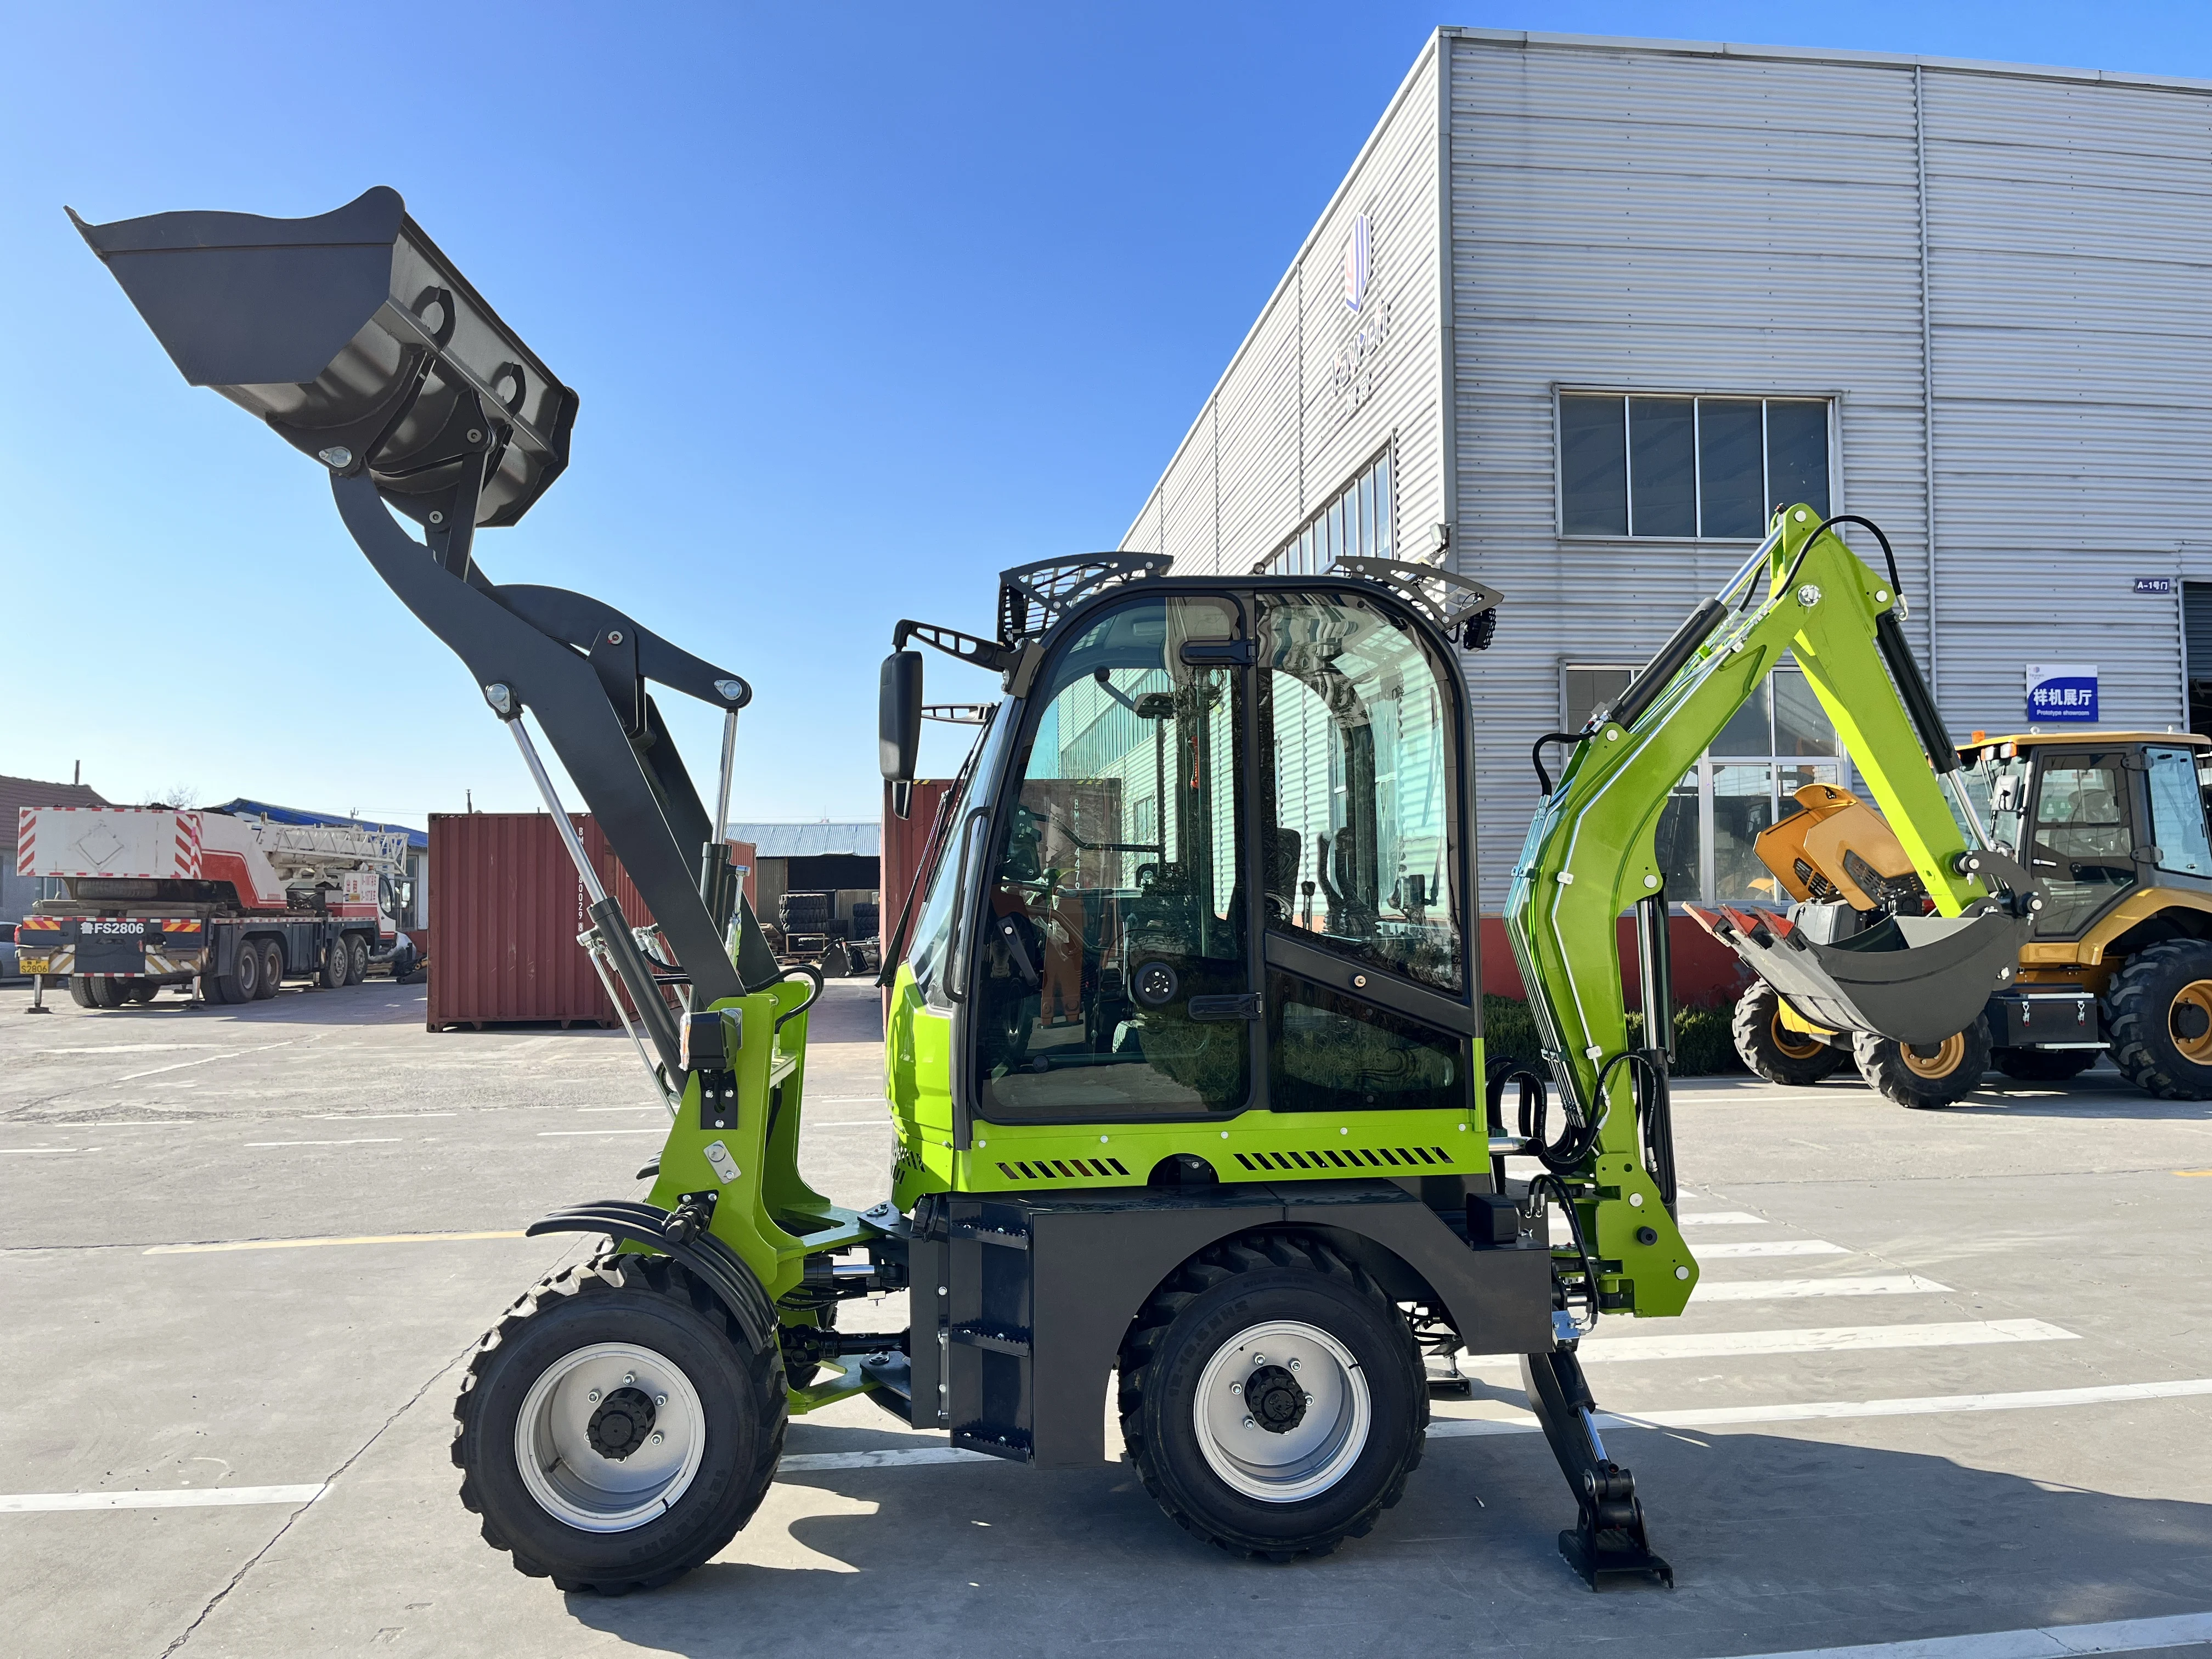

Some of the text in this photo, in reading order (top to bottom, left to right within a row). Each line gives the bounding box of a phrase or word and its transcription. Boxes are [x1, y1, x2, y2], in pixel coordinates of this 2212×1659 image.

[2137, 581, 2168, 590] A-1号门
[2033, 688, 2092, 706] 样机展厅
[80, 922, 144, 934] 鲁FS2806
[21, 965, 48, 973] S2806
